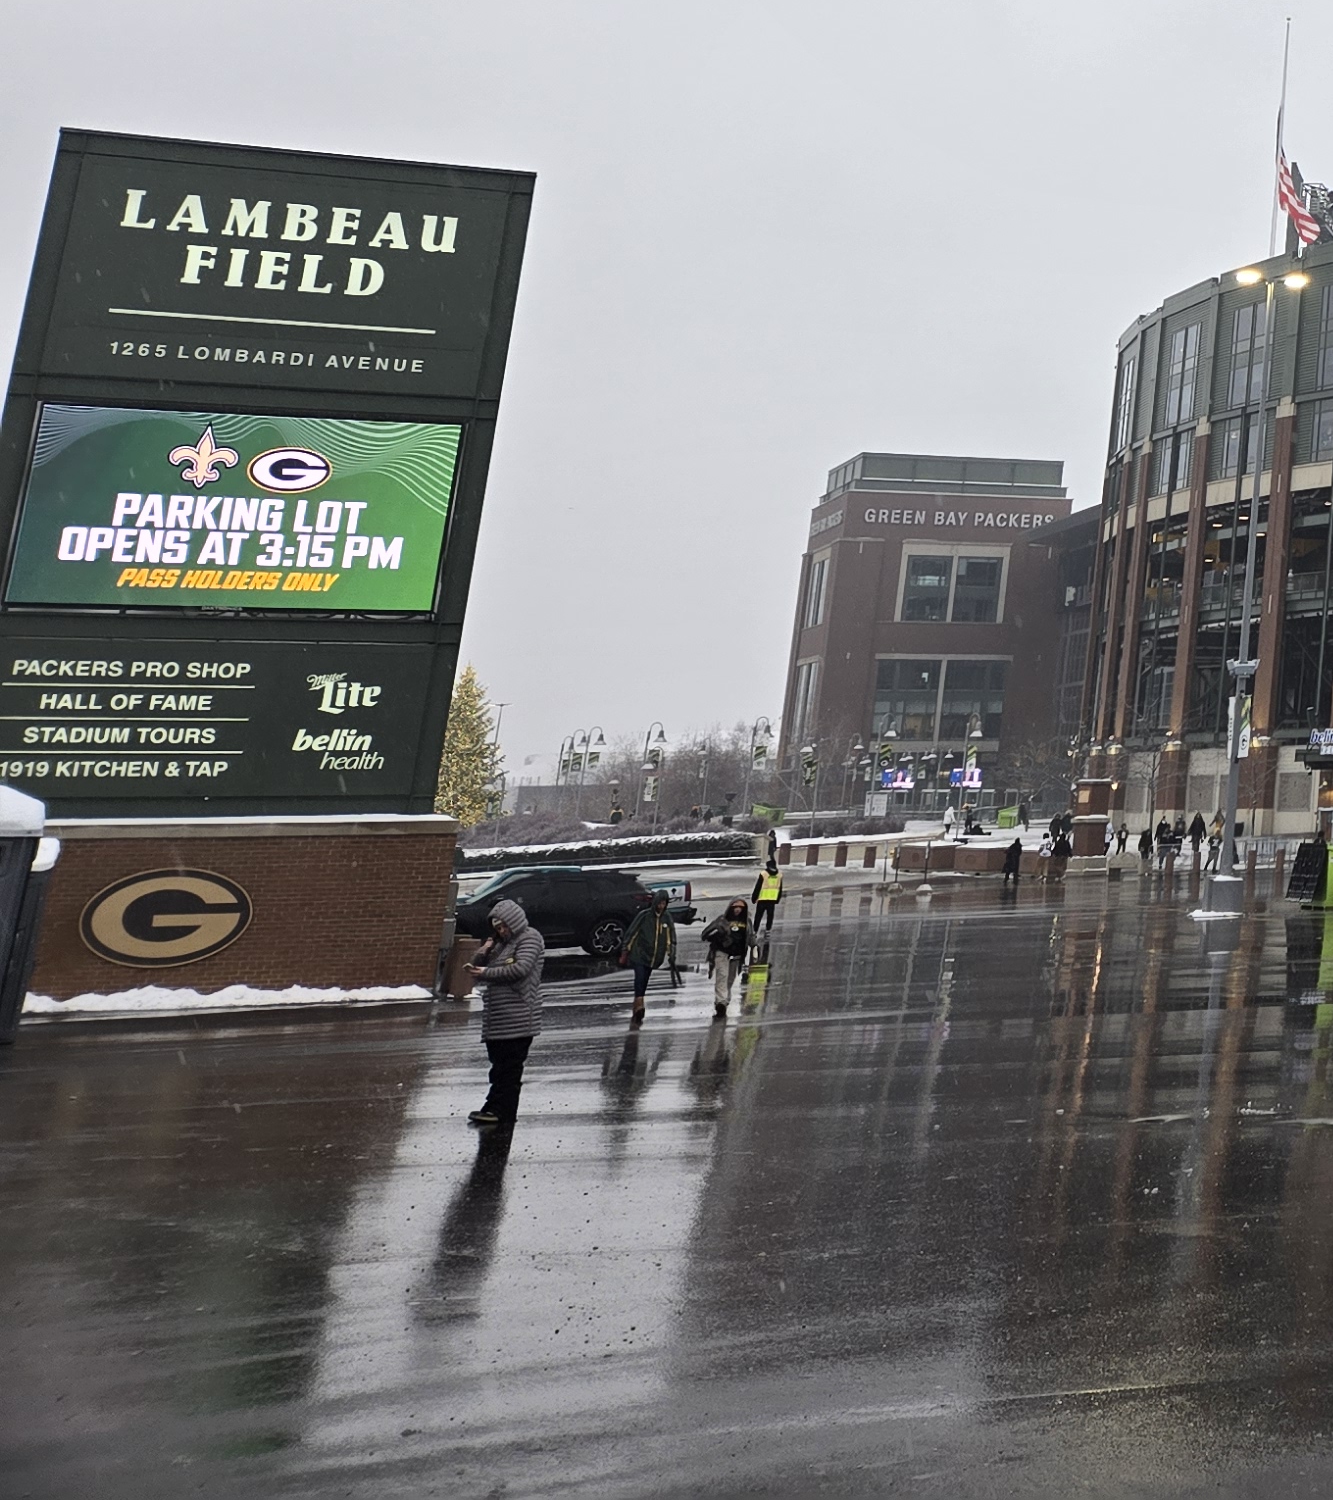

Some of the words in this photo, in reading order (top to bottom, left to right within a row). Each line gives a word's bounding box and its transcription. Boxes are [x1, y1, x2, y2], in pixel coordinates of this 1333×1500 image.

[120, 189, 459, 254] LAMBEAU
[180, 244, 386, 296] FIELD
[109, 341, 168, 358] 1265
[177, 345, 315, 368] LOMBARDI
[325, 355, 426, 374] AVENUE
[111, 493, 284, 532] PARKING
[292, 501, 367, 534] LOT
[864, 508, 926, 525] GREEN
[933, 511, 968, 526] BAY
[57, 526, 188, 564] OPENS
[197, 531, 252, 567] AT
[256, 534, 337, 569] 3:15
[341, 537, 403, 570] PM
[116, 569, 179, 589] PASS
[180, 571, 280, 591] HOLDERS
[282, 573, 339, 592] ONLY
[12, 659, 123, 678] PACKERS
[130, 661, 179, 678] PRO
[185, 662, 251, 679] SHOP
[307, 672, 347, 690] Miller
[40, 693, 102, 710] HALL
[110, 694, 143, 711] OF
[149, 695, 212, 712] FAME
[317, 679, 381, 714] Lite
[23, 727, 130, 744] STADIUM
[136, 728, 216, 745] TOURS
[292, 729, 372, 752] bellin
[0, 761, 49, 778] 1919
[55, 761, 159, 778] KITCHEN
[164, 761, 180, 778] &
[185, 761, 228, 778] TAP
[319, 752, 384, 771] health
[91, 877, 241, 959] G
